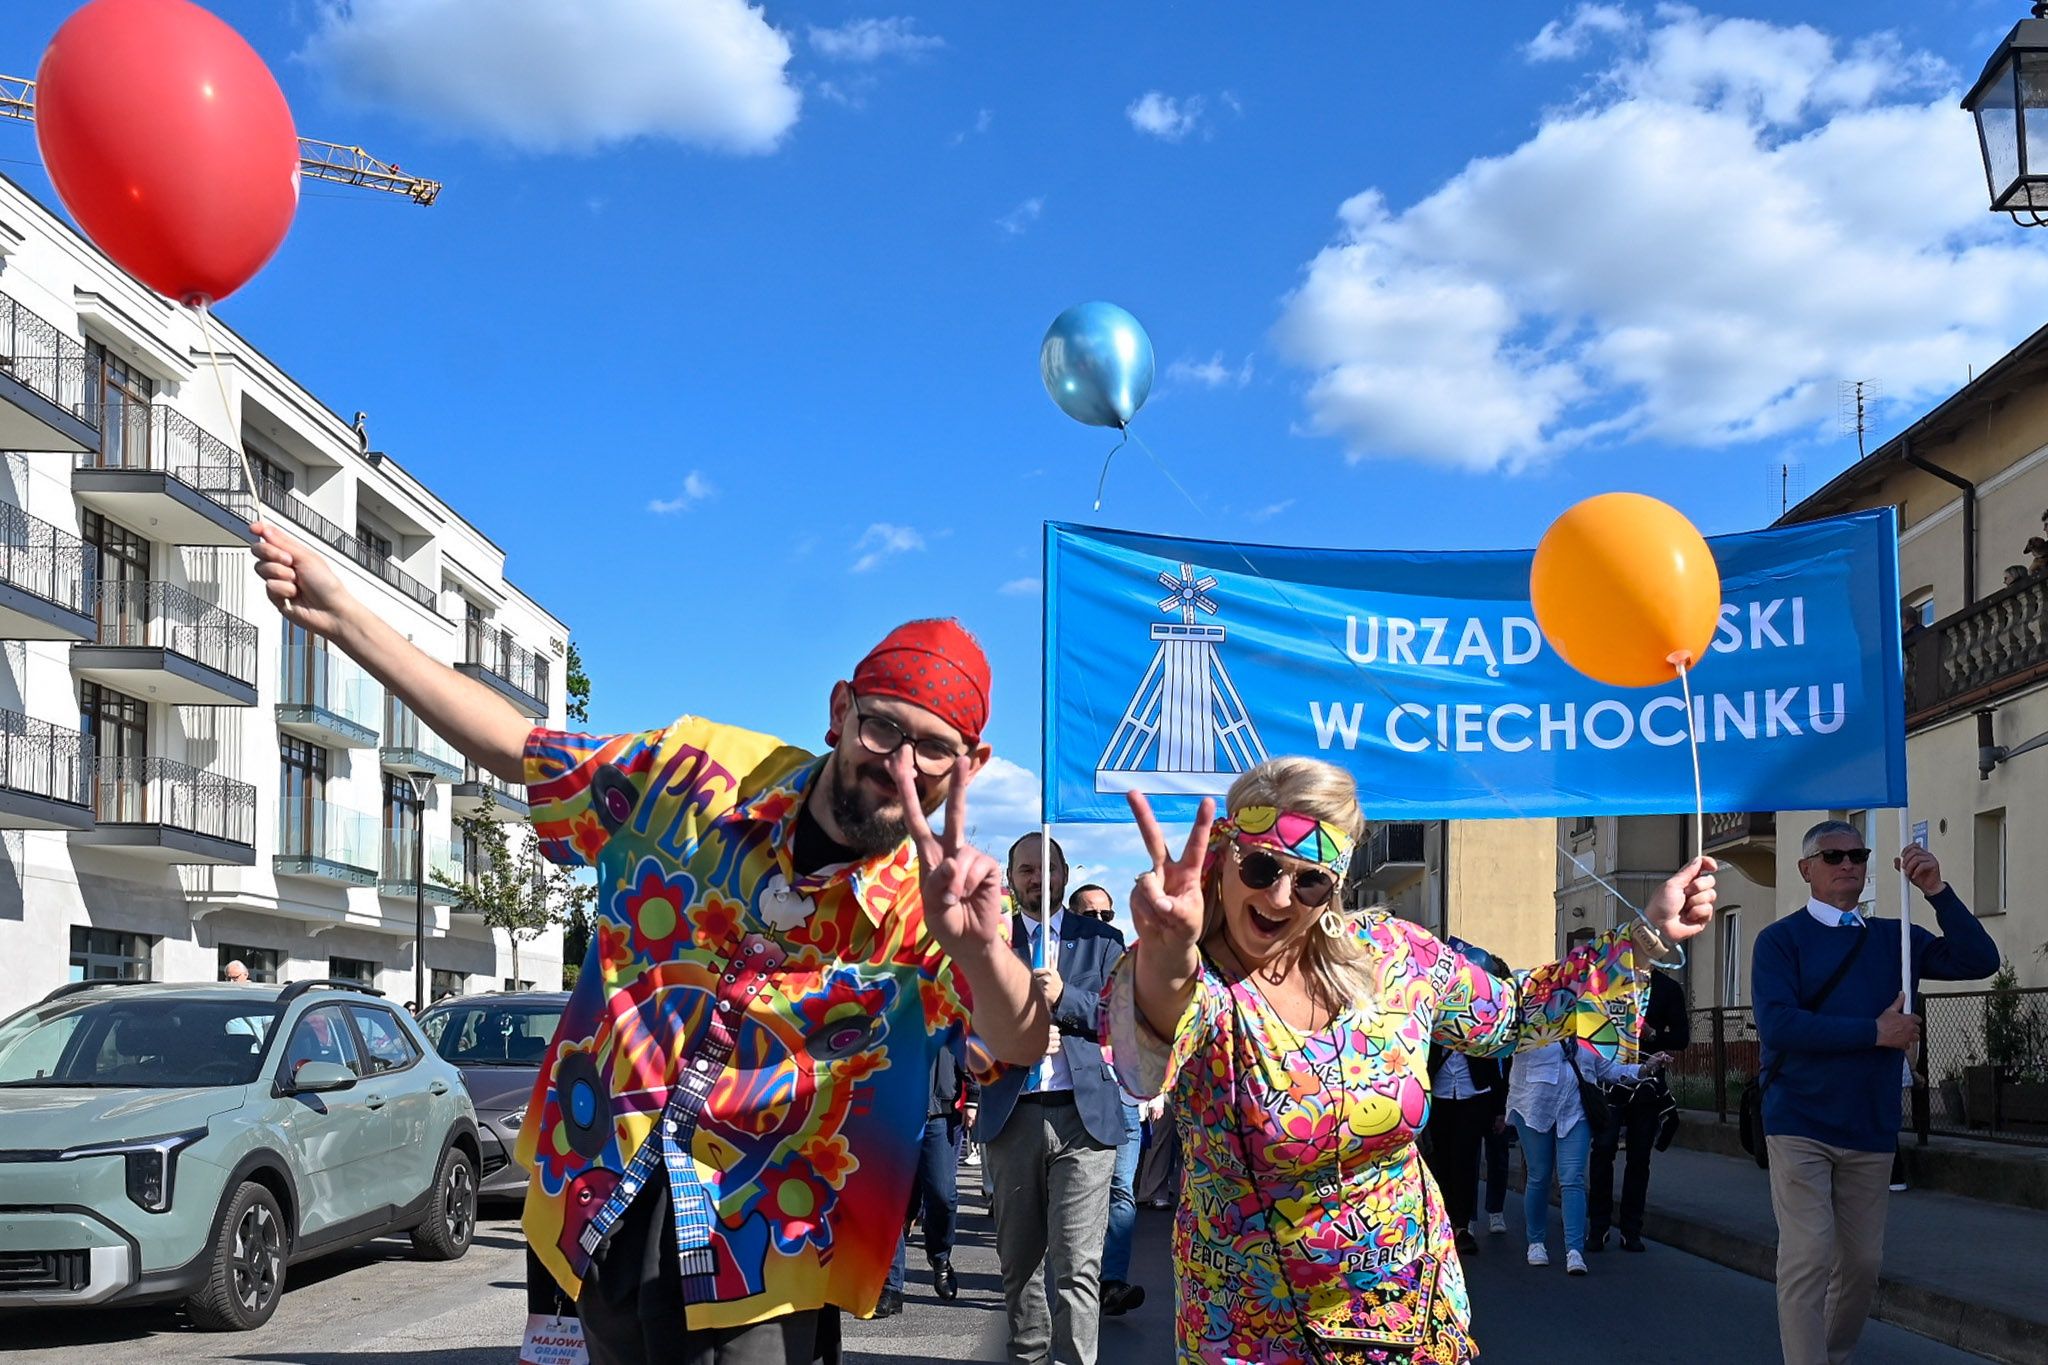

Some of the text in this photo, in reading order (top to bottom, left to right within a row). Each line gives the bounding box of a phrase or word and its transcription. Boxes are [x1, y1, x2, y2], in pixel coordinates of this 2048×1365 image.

[1346, 596, 1806, 677] URZĄD SKI
[1310, 683, 1845, 753] W CIECHOCINKU
[1191, 1242, 1237, 1275] EACE
[531, 1335, 587, 1348] MAJOWE
[534, 1346, 579, 1358] GRANIE
